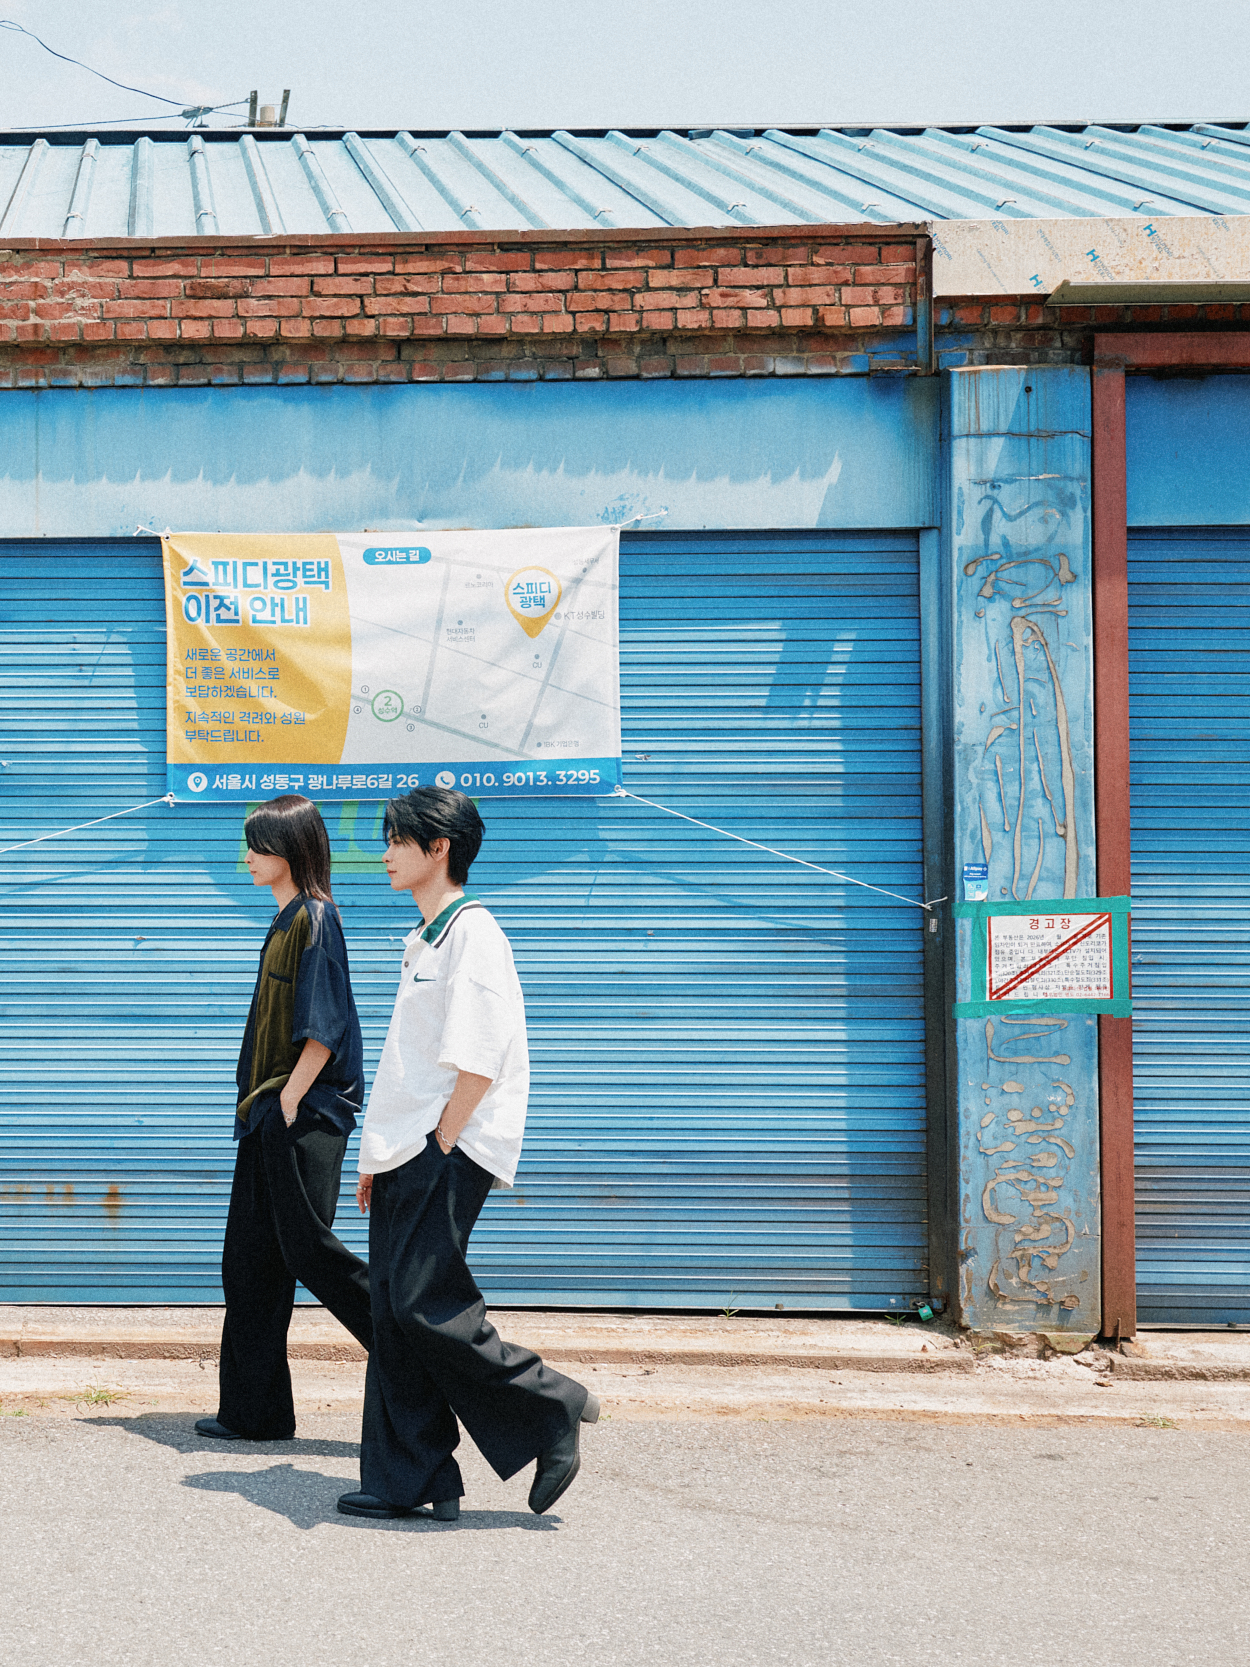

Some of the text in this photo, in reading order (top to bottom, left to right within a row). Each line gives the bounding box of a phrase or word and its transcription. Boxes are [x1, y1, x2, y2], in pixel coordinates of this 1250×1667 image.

[374, 550, 420, 562] 오시는 길
[182, 558, 330, 590] 스피디광택
[512, 582, 552, 595] 스피디
[520, 595, 546, 608] 광택
[184, 594, 308, 625] 이전 안내
[184, 648, 276, 662] 새로운 공간에서
[185, 666, 280, 680] 더 좋은 서비스로
[185, 685, 278, 698] 보답하겠습니다.
[384, 696, 392, 706] 2
[185, 711, 306, 725] 지속적인 격려와 성원
[185, 730, 264, 743] 부탁드립니다.
[212, 774, 419, 790] 서울시 성동구 광나루로6길 26
[460, 770, 600, 787] 010. 9013. 3295
